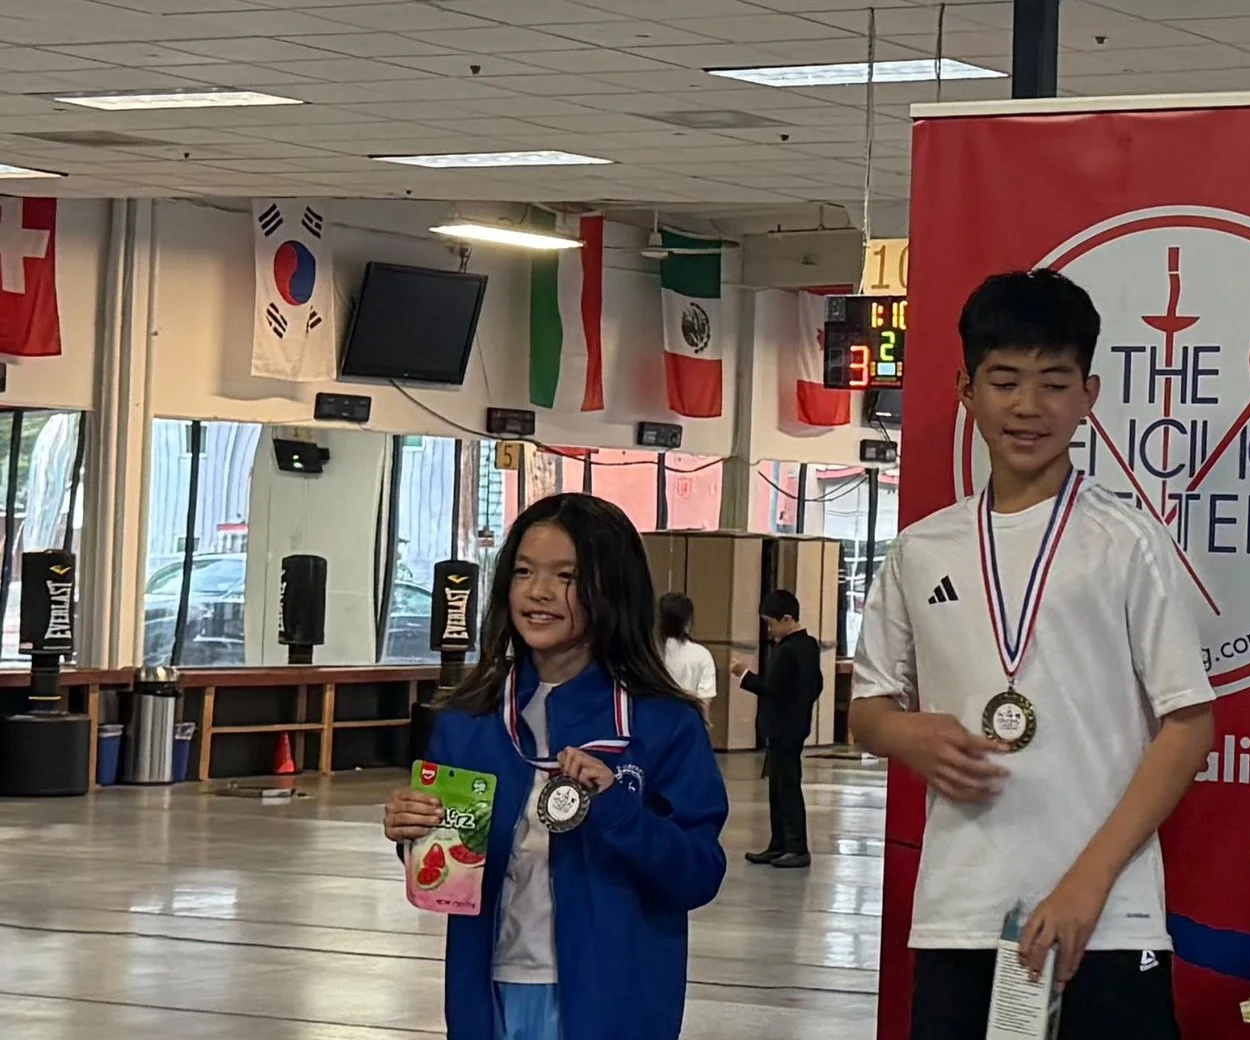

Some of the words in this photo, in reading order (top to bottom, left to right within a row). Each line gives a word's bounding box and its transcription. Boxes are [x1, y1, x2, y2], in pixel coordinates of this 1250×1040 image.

[849, 345, 869, 386] 3
[1111, 345, 1221, 404] THE
[504, 445, 513, 467] 5
[44, 580, 73, 640] EVERLAST
[442, 587, 472, 640] EVERLAST
